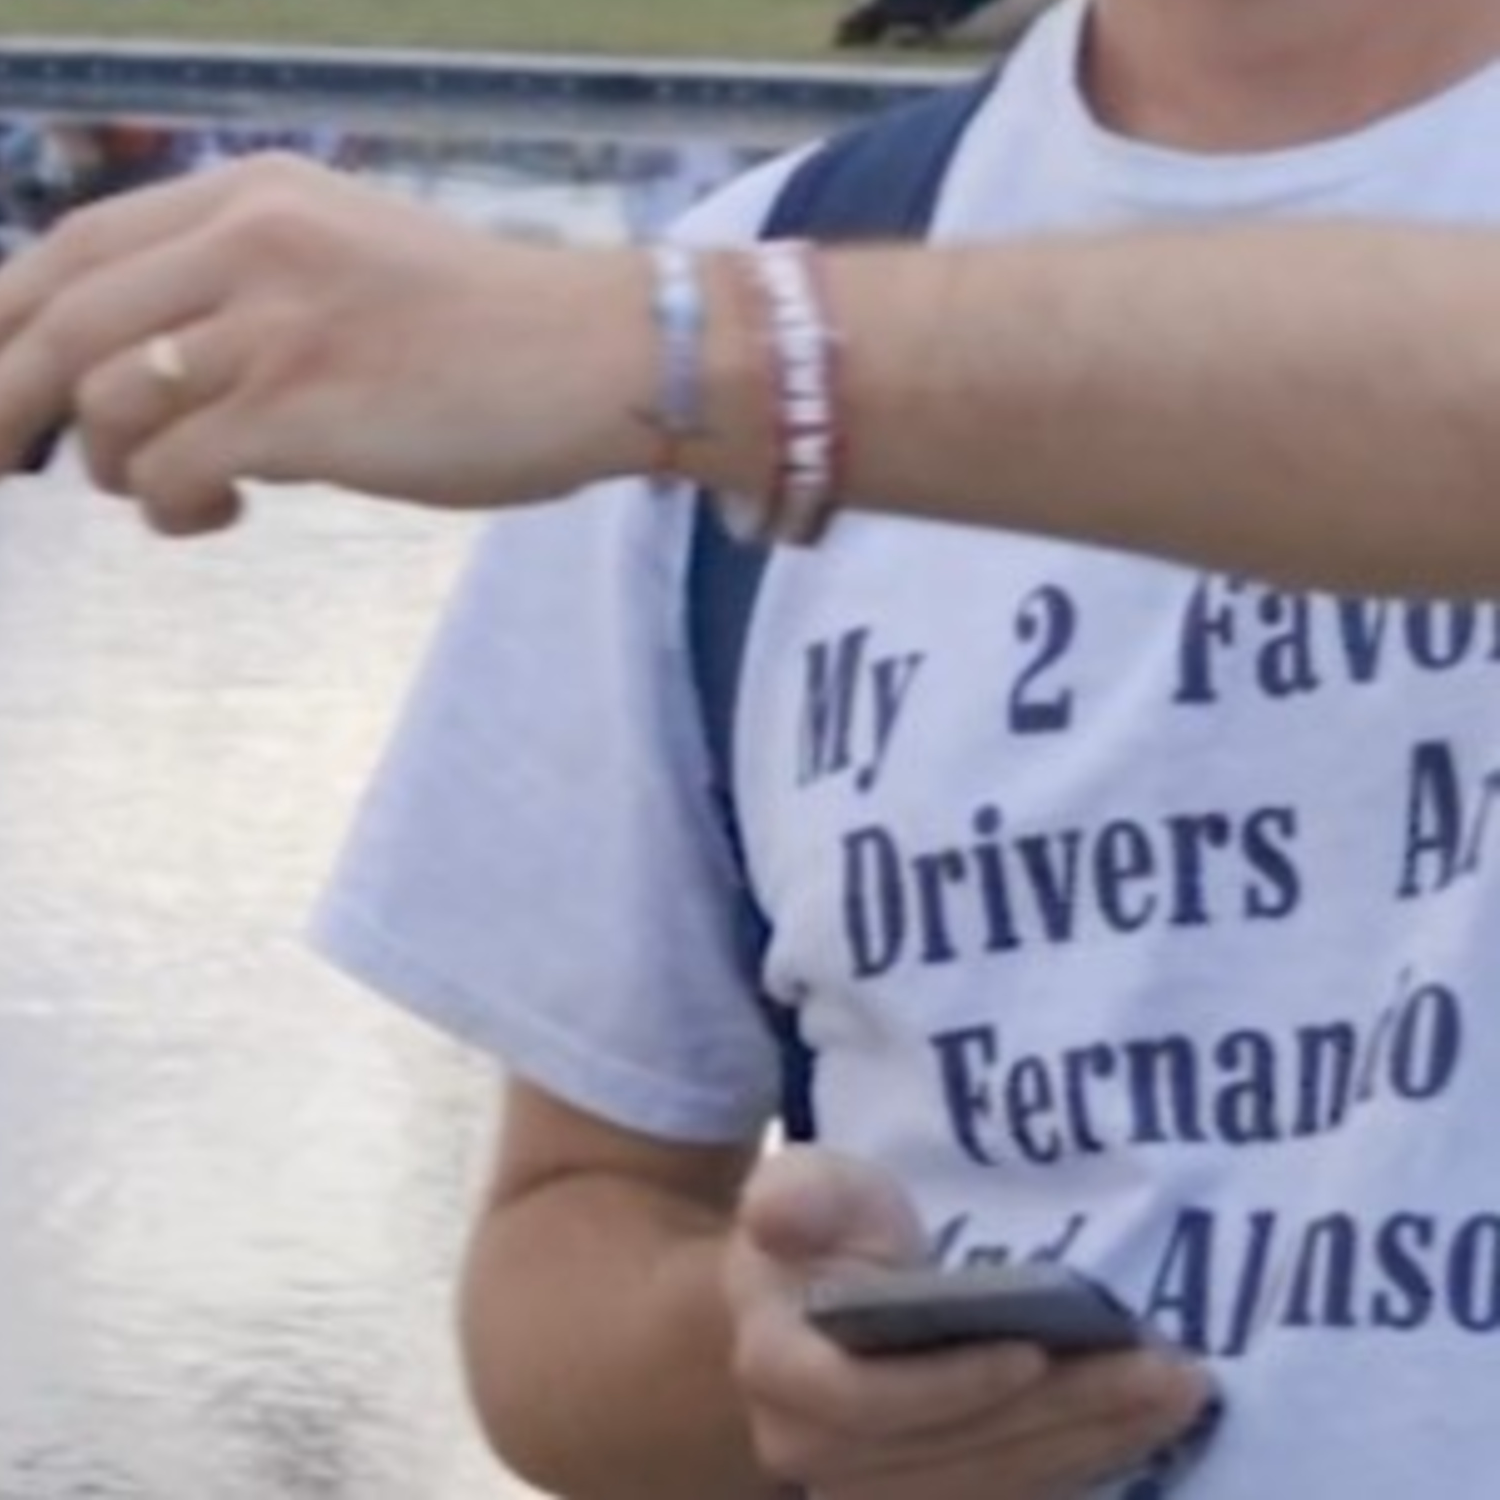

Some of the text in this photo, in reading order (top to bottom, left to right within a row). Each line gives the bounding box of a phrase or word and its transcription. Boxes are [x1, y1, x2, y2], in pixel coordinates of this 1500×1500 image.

[797, 574, 1500, 793] My 2 Favo
[842, 740, 1500, 981] Drivers Ar
